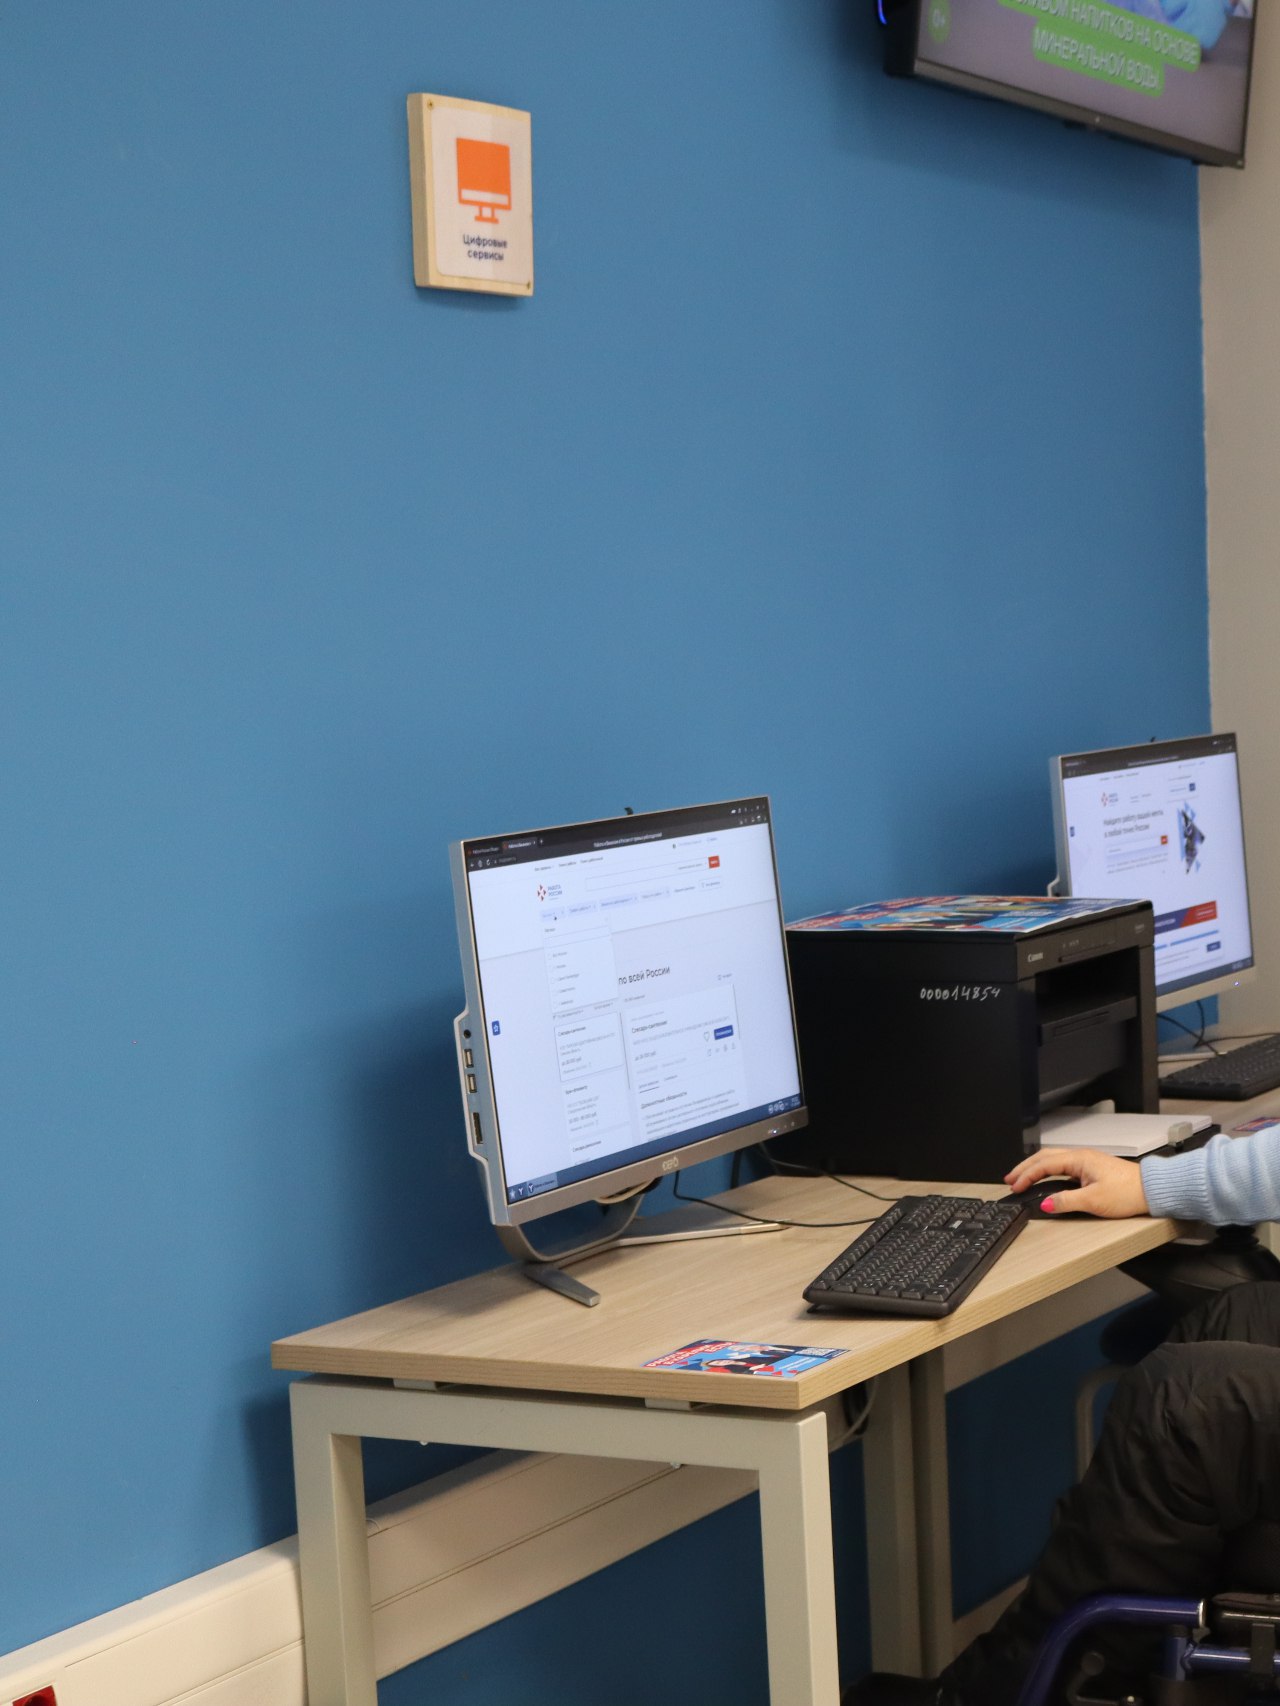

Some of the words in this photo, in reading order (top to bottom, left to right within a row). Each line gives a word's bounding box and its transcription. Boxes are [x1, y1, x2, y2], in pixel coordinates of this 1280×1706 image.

[1072, 3, 1134, 43] НАПИТКОВ
[1136, 25, 1151, 48] НА
[1152, 29, 1199, 65] ОСНОВЕ
[1033, 27, 1125, 77] МИНЕРАЛЬНОЙ
[1126, 59, 1160, 91] ВОДЫ
[463, 233, 507, 249] Цифровые
[467, 250, 504, 261] сервисы
[618, 976, 627, 985] по
[628, 971, 645, 983] всей
[646, 966, 671, 979] России
